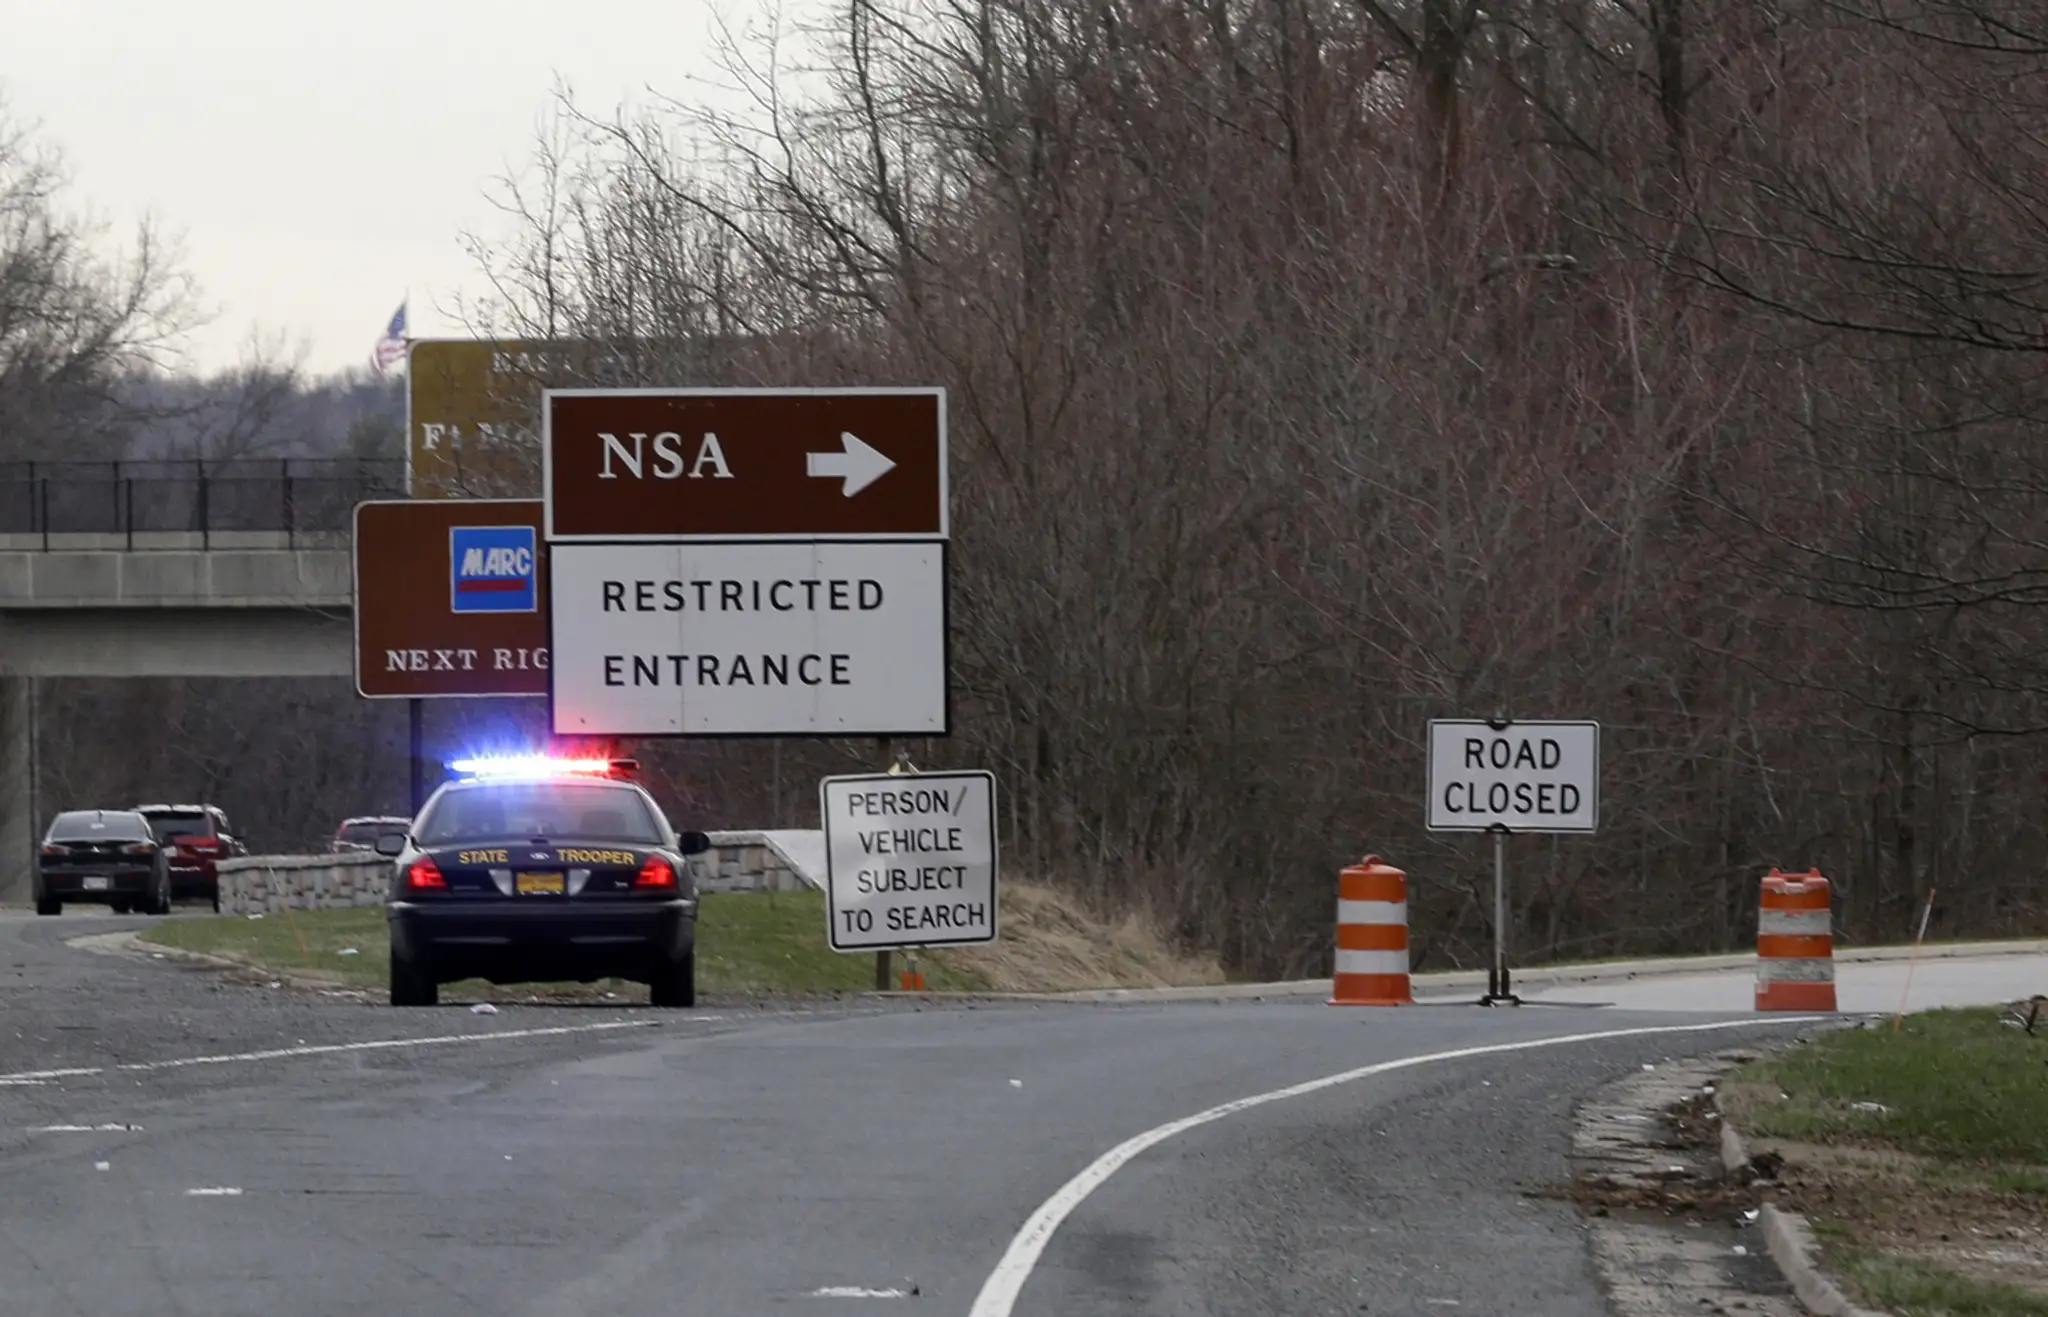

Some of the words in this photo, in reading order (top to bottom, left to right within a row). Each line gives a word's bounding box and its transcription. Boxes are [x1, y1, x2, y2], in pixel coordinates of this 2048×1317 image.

[598, 431, 734, 479] NSA
[460, 545, 533, 576] MARC
[603, 579, 884, 611] RESTRICTED
[386, 649, 478, 672] NEXT
[605, 654, 852, 686] ENTRANCE
[1465, 738, 1561, 769] ROAD
[849, 786, 967, 816] PERSON/
[1444, 782, 1580, 814] CLOSED
[858, 828, 963, 854] VEHICLE
[459, 849, 509, 864] STATE
[556, 849, 636, 865] TROOPER
[857, 867, 967, 893] SUBJECT
[842, 910, 873, 932] TO
[887, 903, 985, 930] SEARCH
